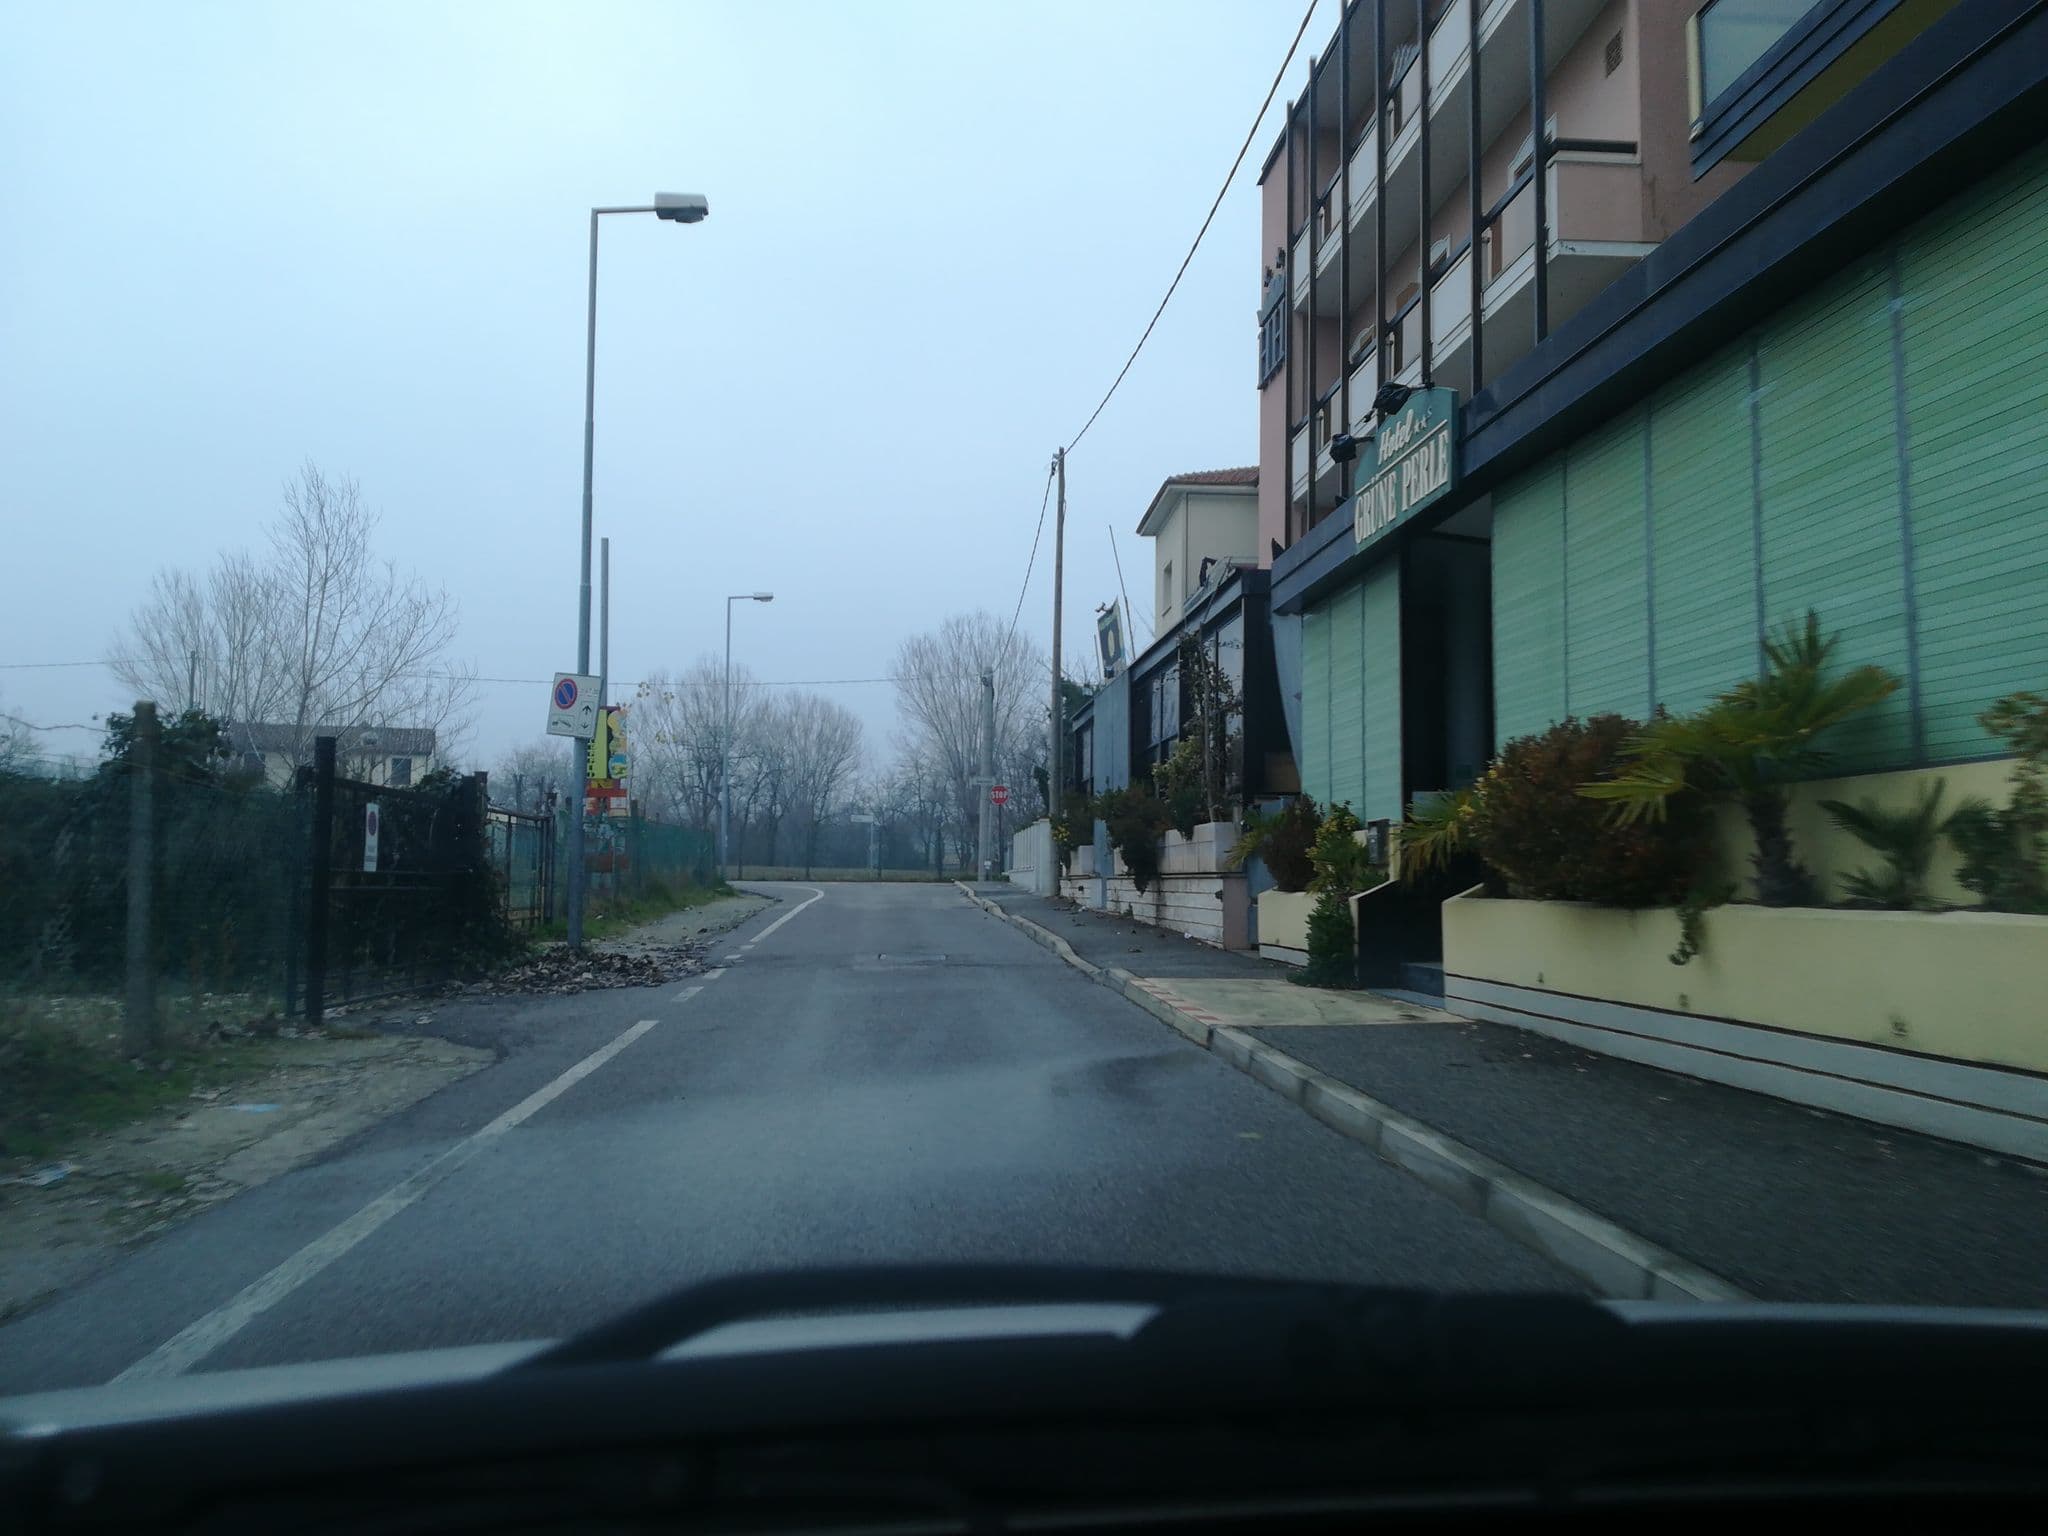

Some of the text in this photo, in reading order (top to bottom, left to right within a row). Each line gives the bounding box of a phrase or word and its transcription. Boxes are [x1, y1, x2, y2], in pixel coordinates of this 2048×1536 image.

[1378, 408, 1415, 465] Hotel
[1401, 429, 1449, 512] PERLE
[991, 791, 1008, 799] STOP
